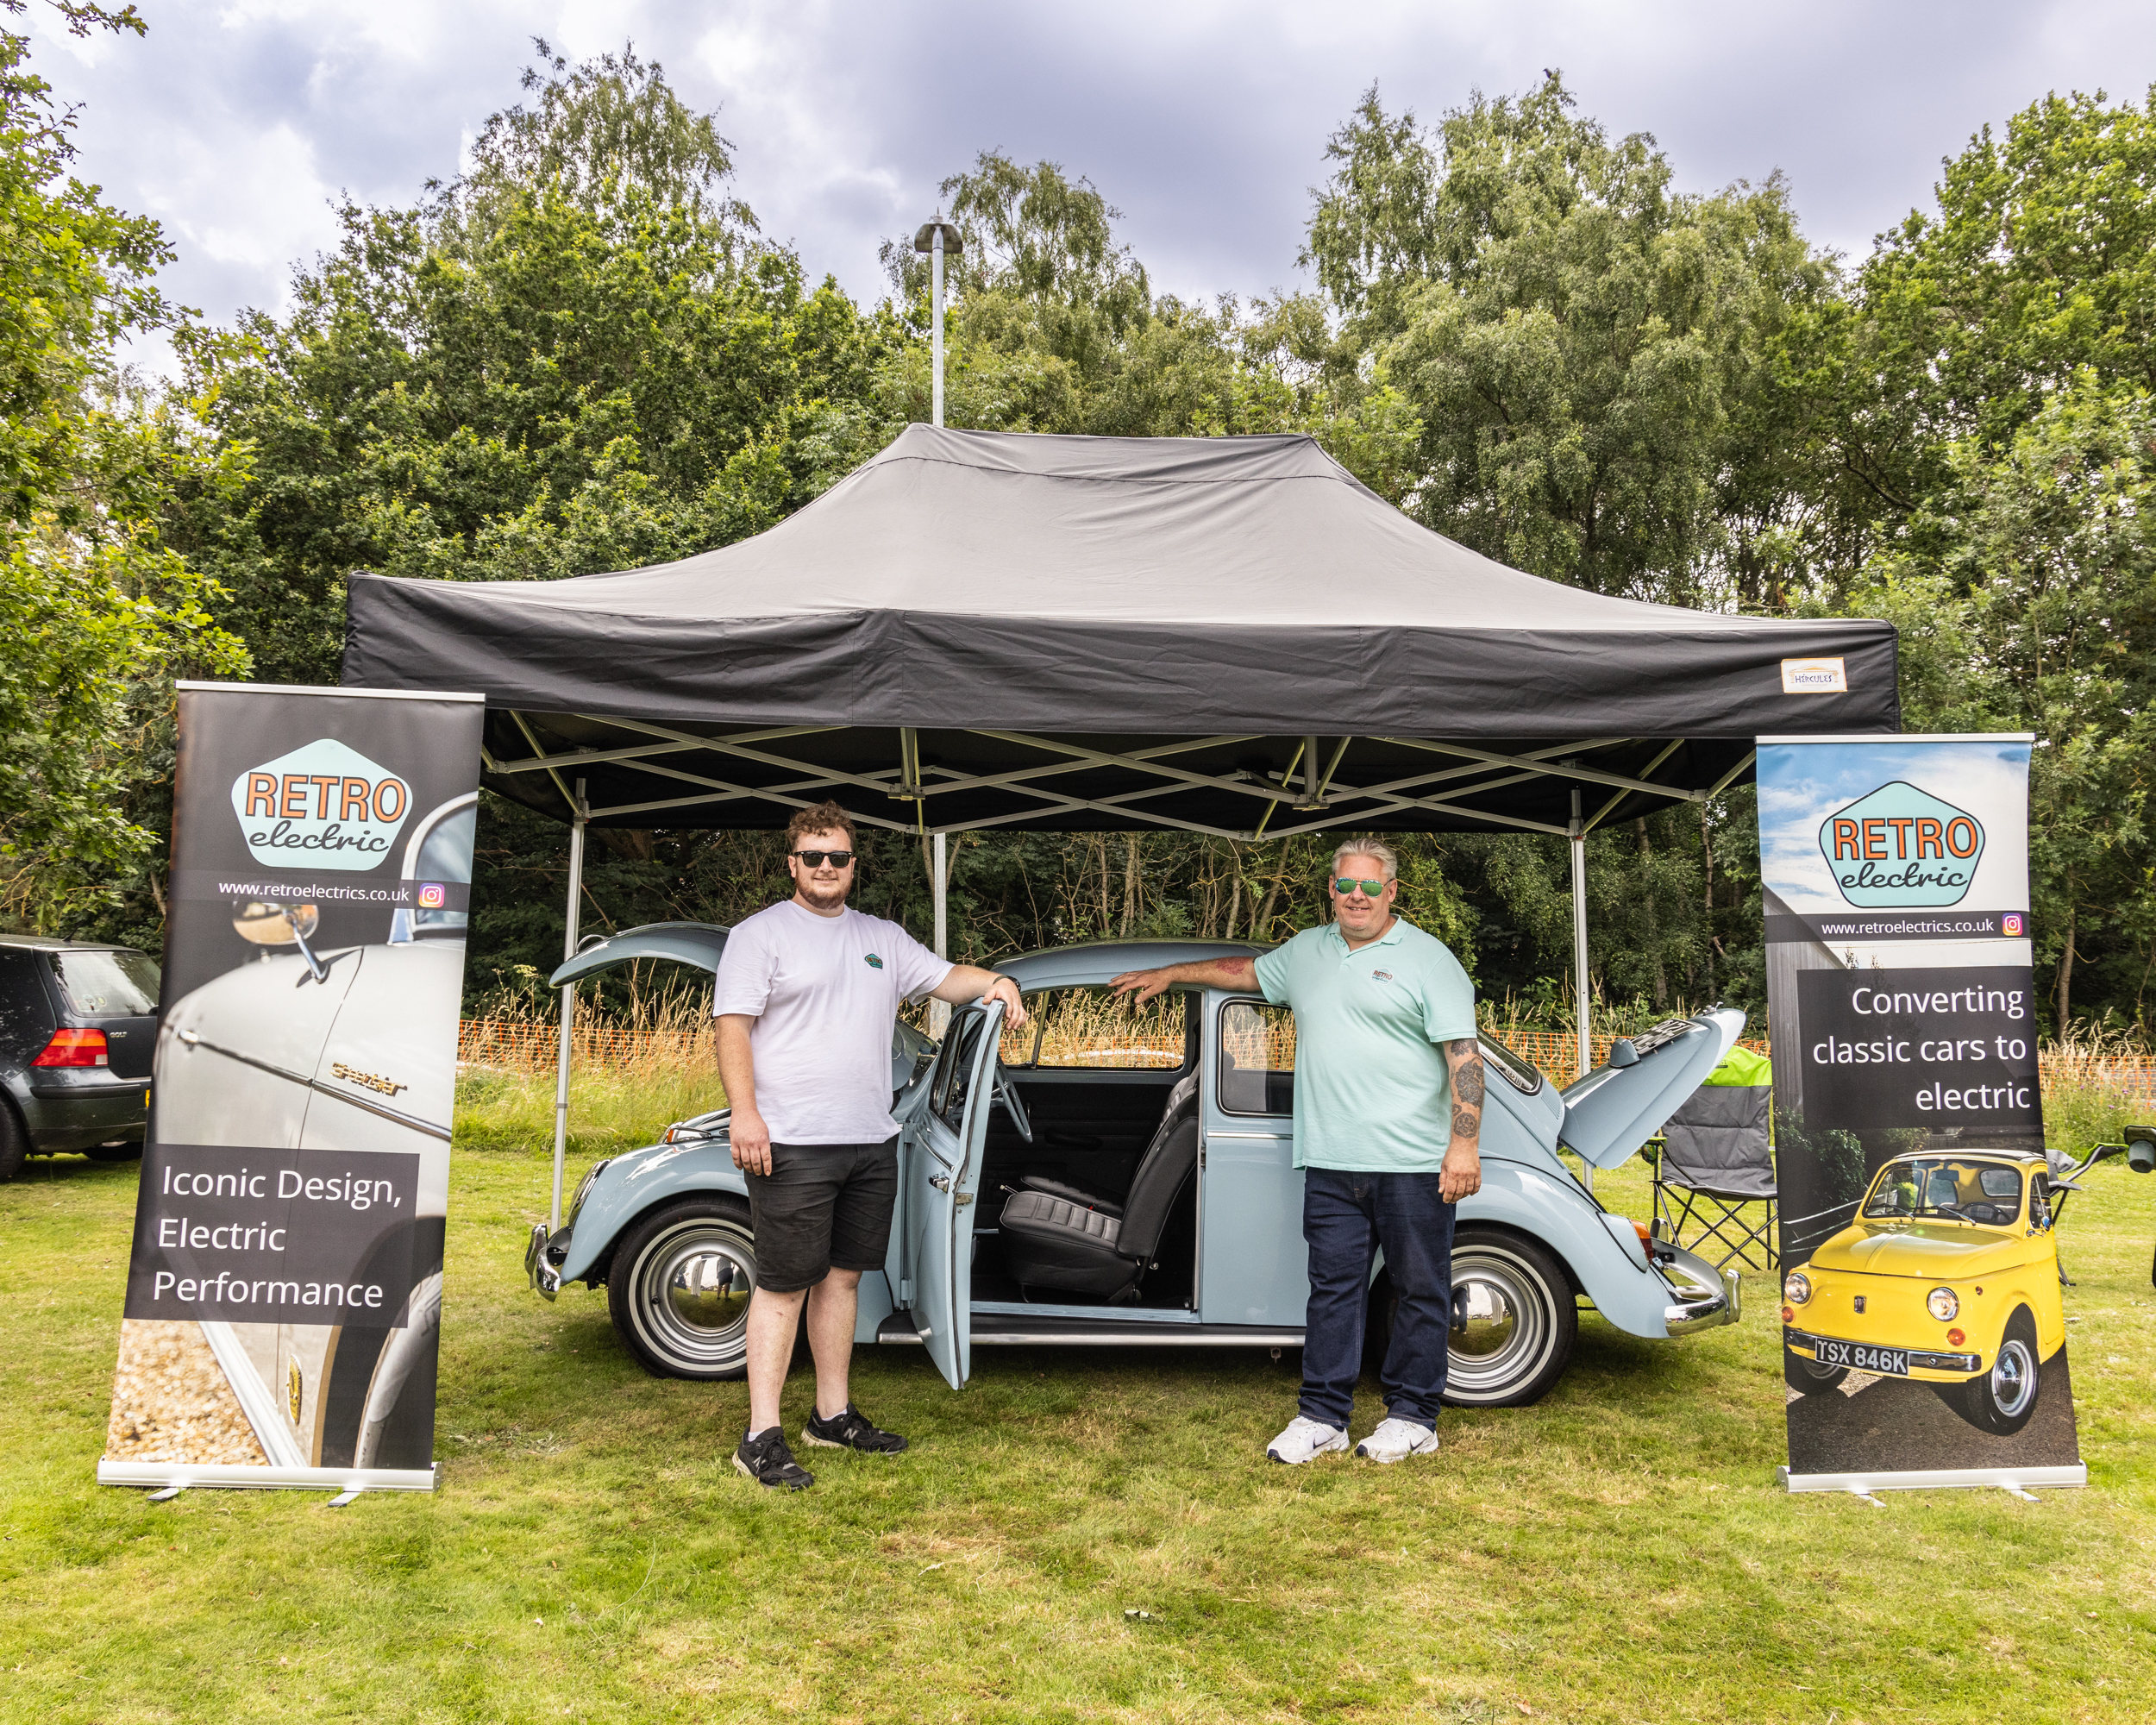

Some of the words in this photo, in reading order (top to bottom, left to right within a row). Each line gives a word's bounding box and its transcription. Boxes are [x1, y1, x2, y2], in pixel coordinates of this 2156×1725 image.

[245, 772, 407, 823] RETRO
[248, 819, 389, 852] electric
[1833, 816, 1978, 861] RETRO
[1840, 862, 1968, 888] electric
[219, 881, 410, 903] www.retroelectrics.co.uk
[1821, 919, 1995, 935] www.retroelectrics.co.uk
[1852, 985, 2024, 1019] Converting
[1813, 1035, 1911, 1064] classic
[1920, 1038, 1986, 1062] cars
[1995, 1035, 2027, 1060] to
[1915, 1081, 2031, 1111] electric
[162, 1166, 266, 1198] Iconic
[277, 1170, 402, 1210] Design,
[158, 1217, 286, 1251] Electric
[154, 1271, 383, 1308] Performance
[1818, 1340, 1850, 1364] TSX
[1854, 1347, 1907, 1373] 846K
